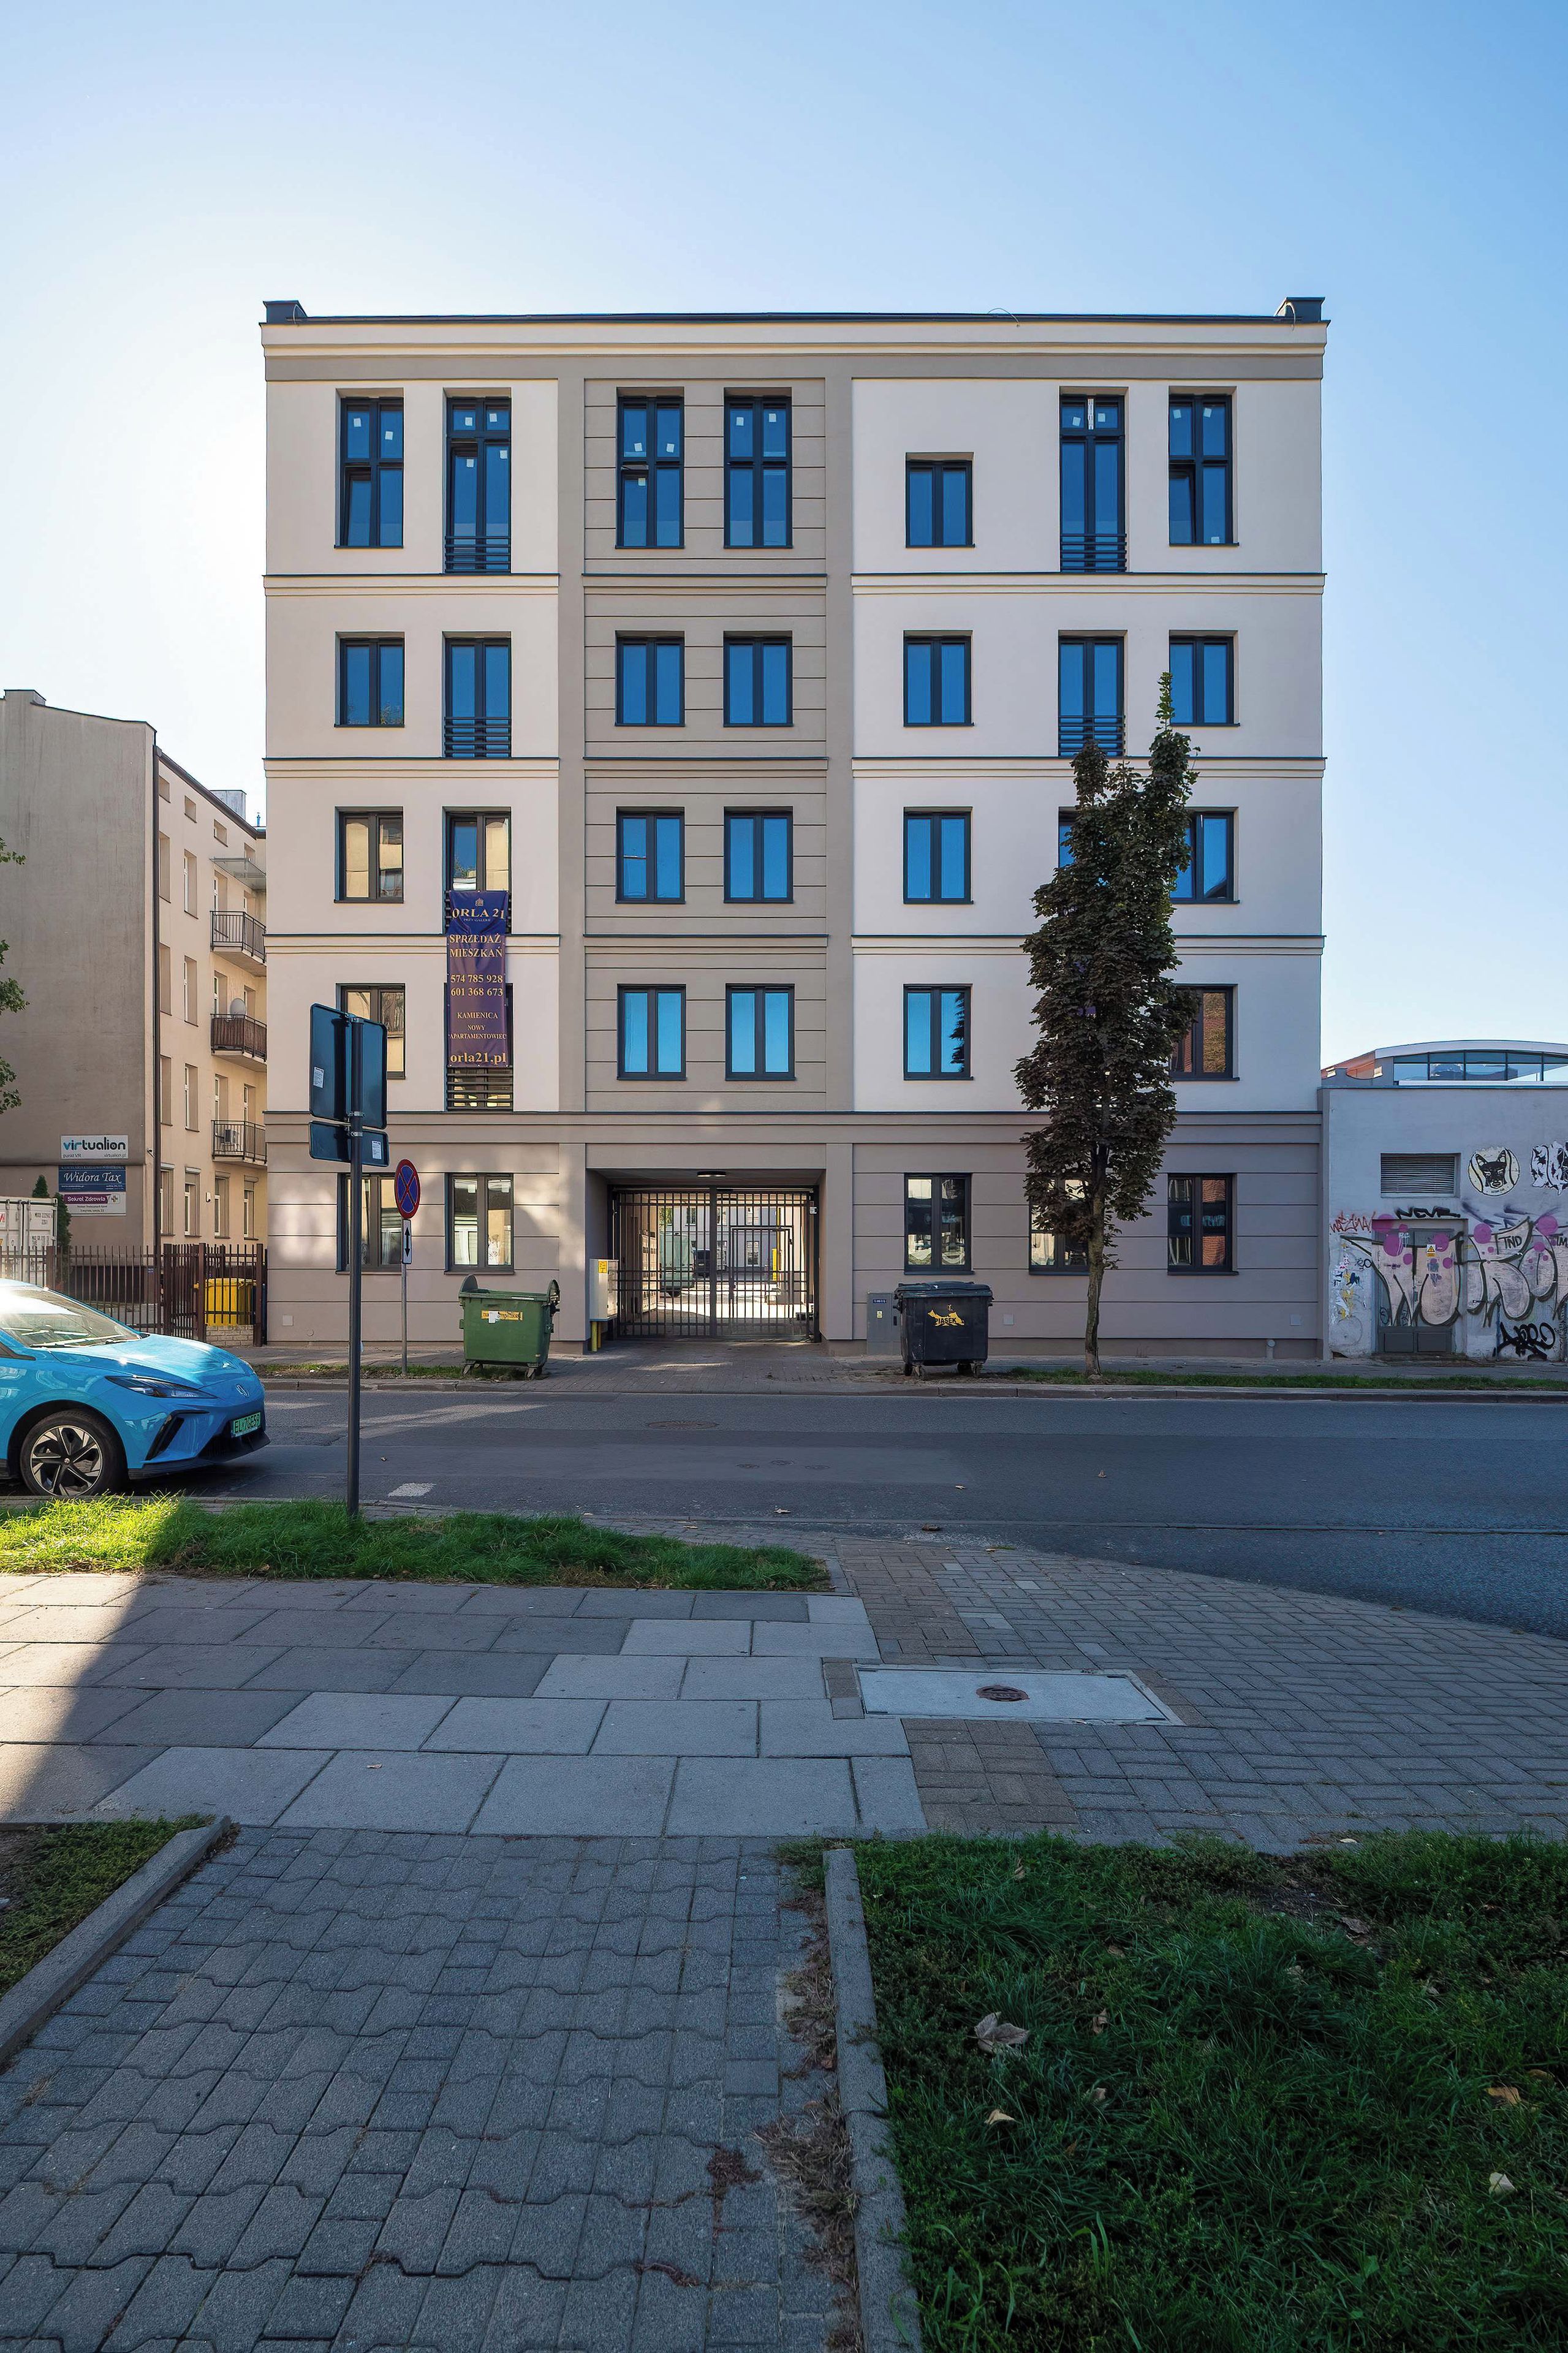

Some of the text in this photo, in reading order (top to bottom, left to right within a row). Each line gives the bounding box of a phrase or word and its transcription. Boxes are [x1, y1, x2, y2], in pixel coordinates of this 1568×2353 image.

[452, 908, 504, 919] ORLA 21
[450, 933, 501, 943] SPRZEDAŻ
[450, 946, 502, 957] MIESZKAŃ
[450, 988, 503, 996] 601 368 673
[450, 1052, 506, 1065] orla21.pl
[63, 1137, 126, 1150] virtualion
[64, 1172, 122, 1184] Widora Tax
